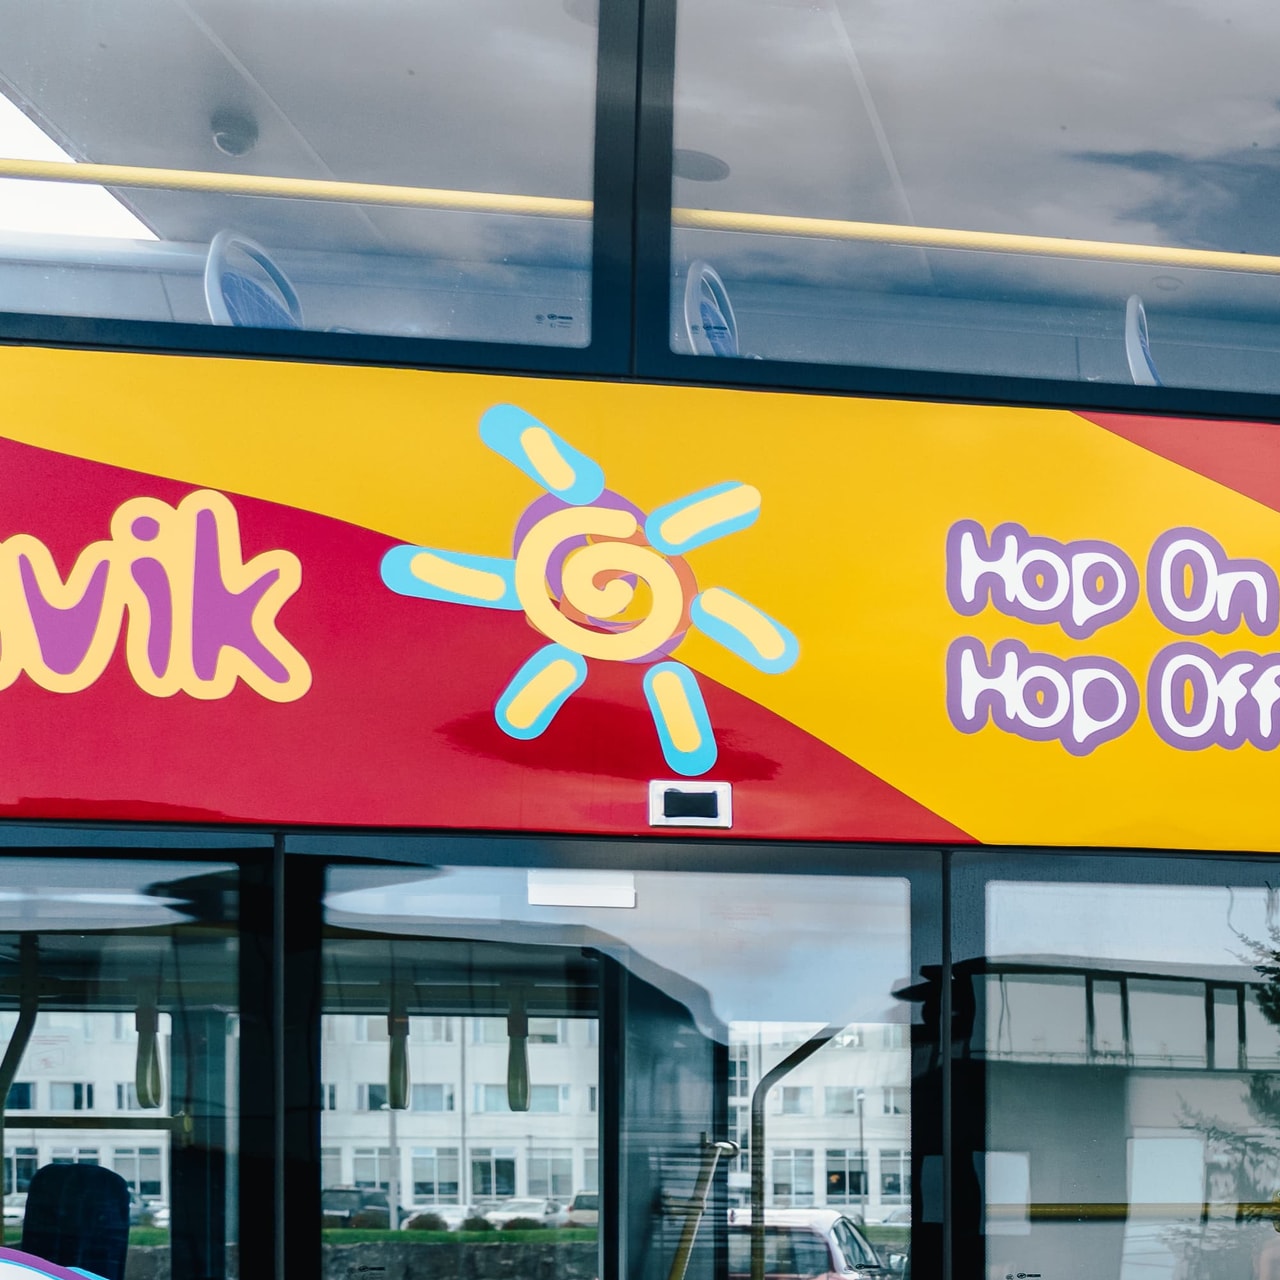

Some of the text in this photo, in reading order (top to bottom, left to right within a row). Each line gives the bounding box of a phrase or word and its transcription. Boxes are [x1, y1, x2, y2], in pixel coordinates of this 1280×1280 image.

[0, 499, 303, 694] vik
[956, 527, 1272, 630] Hop On
[956, 644, 1130, 747] Hop
